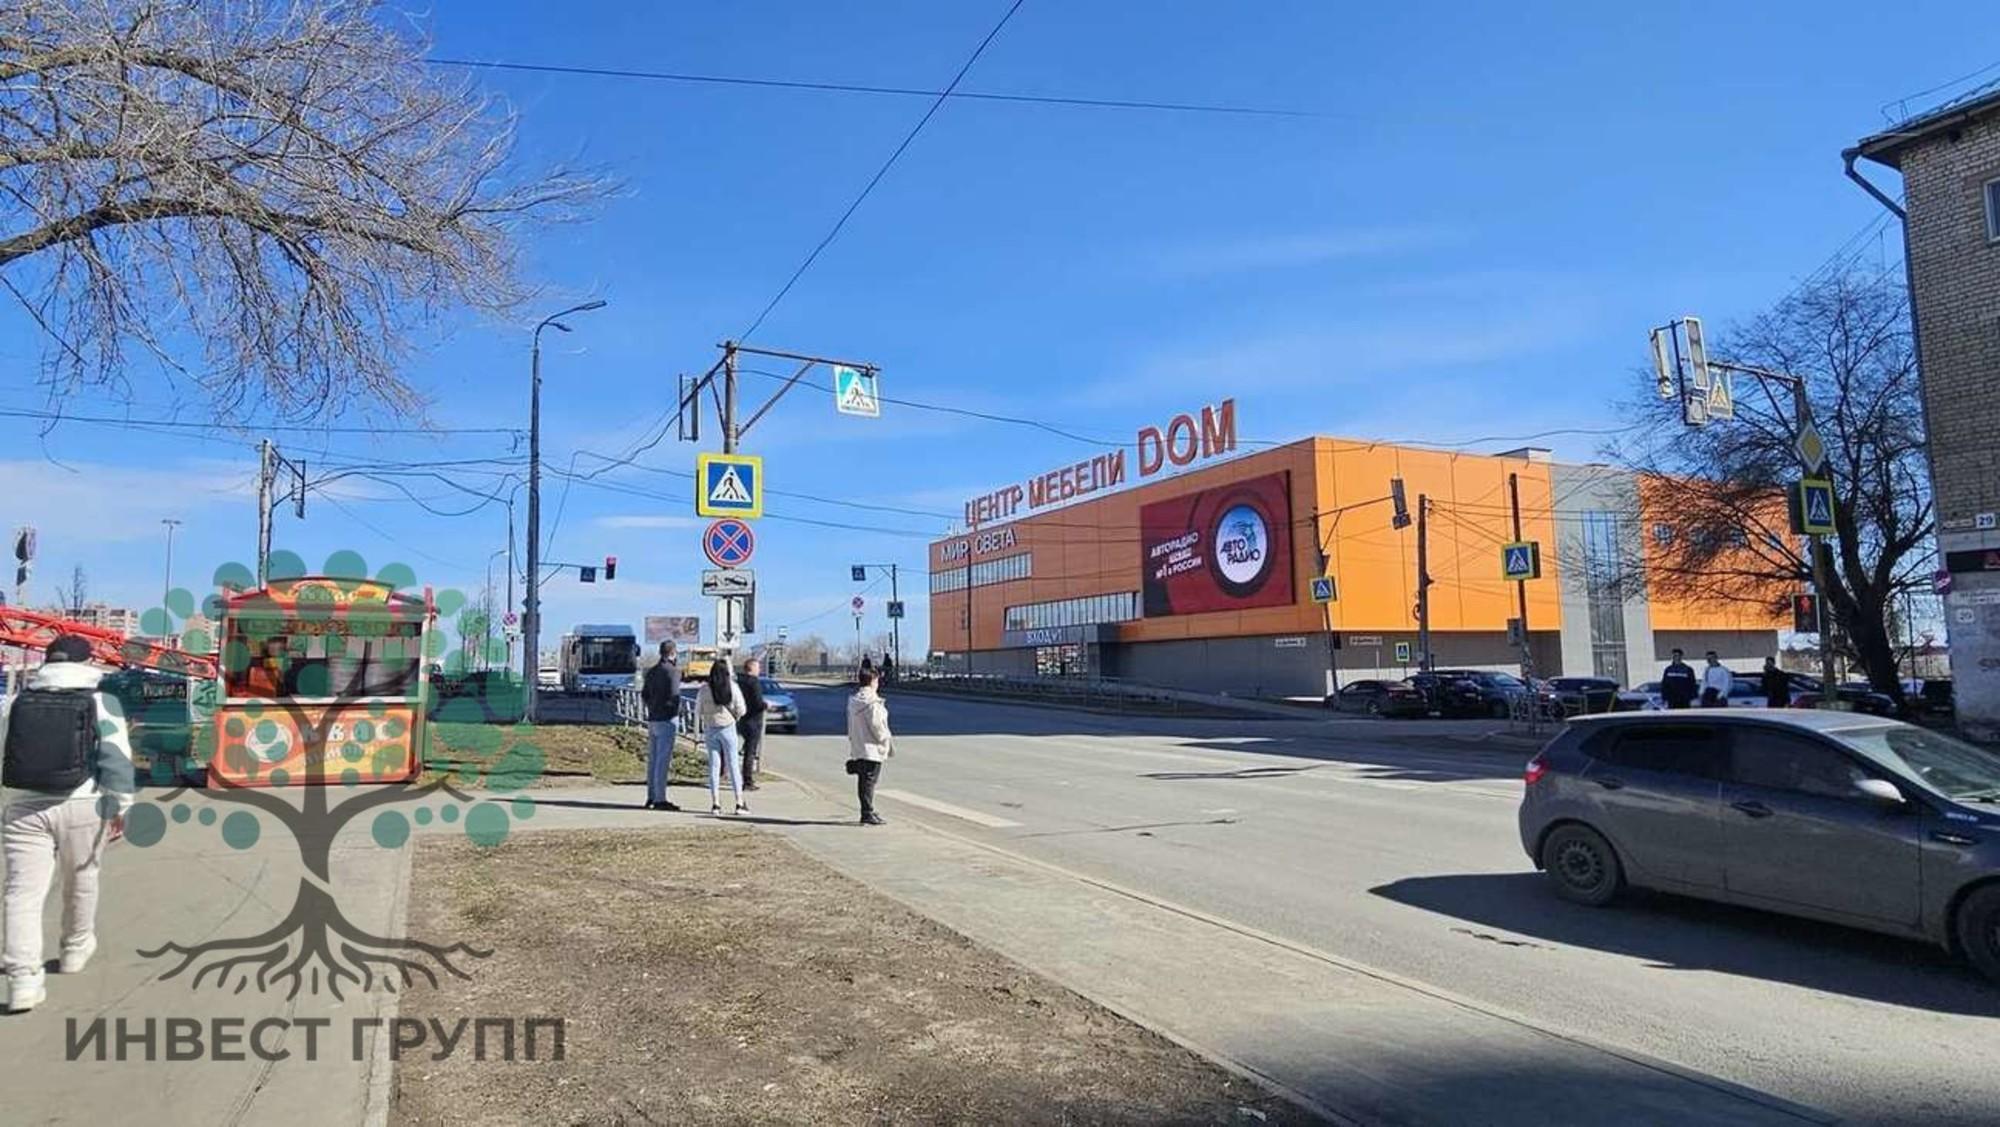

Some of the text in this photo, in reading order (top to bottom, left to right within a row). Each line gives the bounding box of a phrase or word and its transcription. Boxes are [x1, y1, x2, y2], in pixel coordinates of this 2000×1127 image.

[965, 485, 1023, 529] ЦЕНТР
[1028, 449, 1125, 509] МЕБЕЛИ
[941, 528, 1017, 563] МИР СВЕТА
[1151, 532, 1199, 558] АВТОРАДИО
[1221, 538, 1246, 553] АВТО
[1227, 548, 1260, 564] РАДИО
[1172, 556, 1202, 574] РОССИИ
